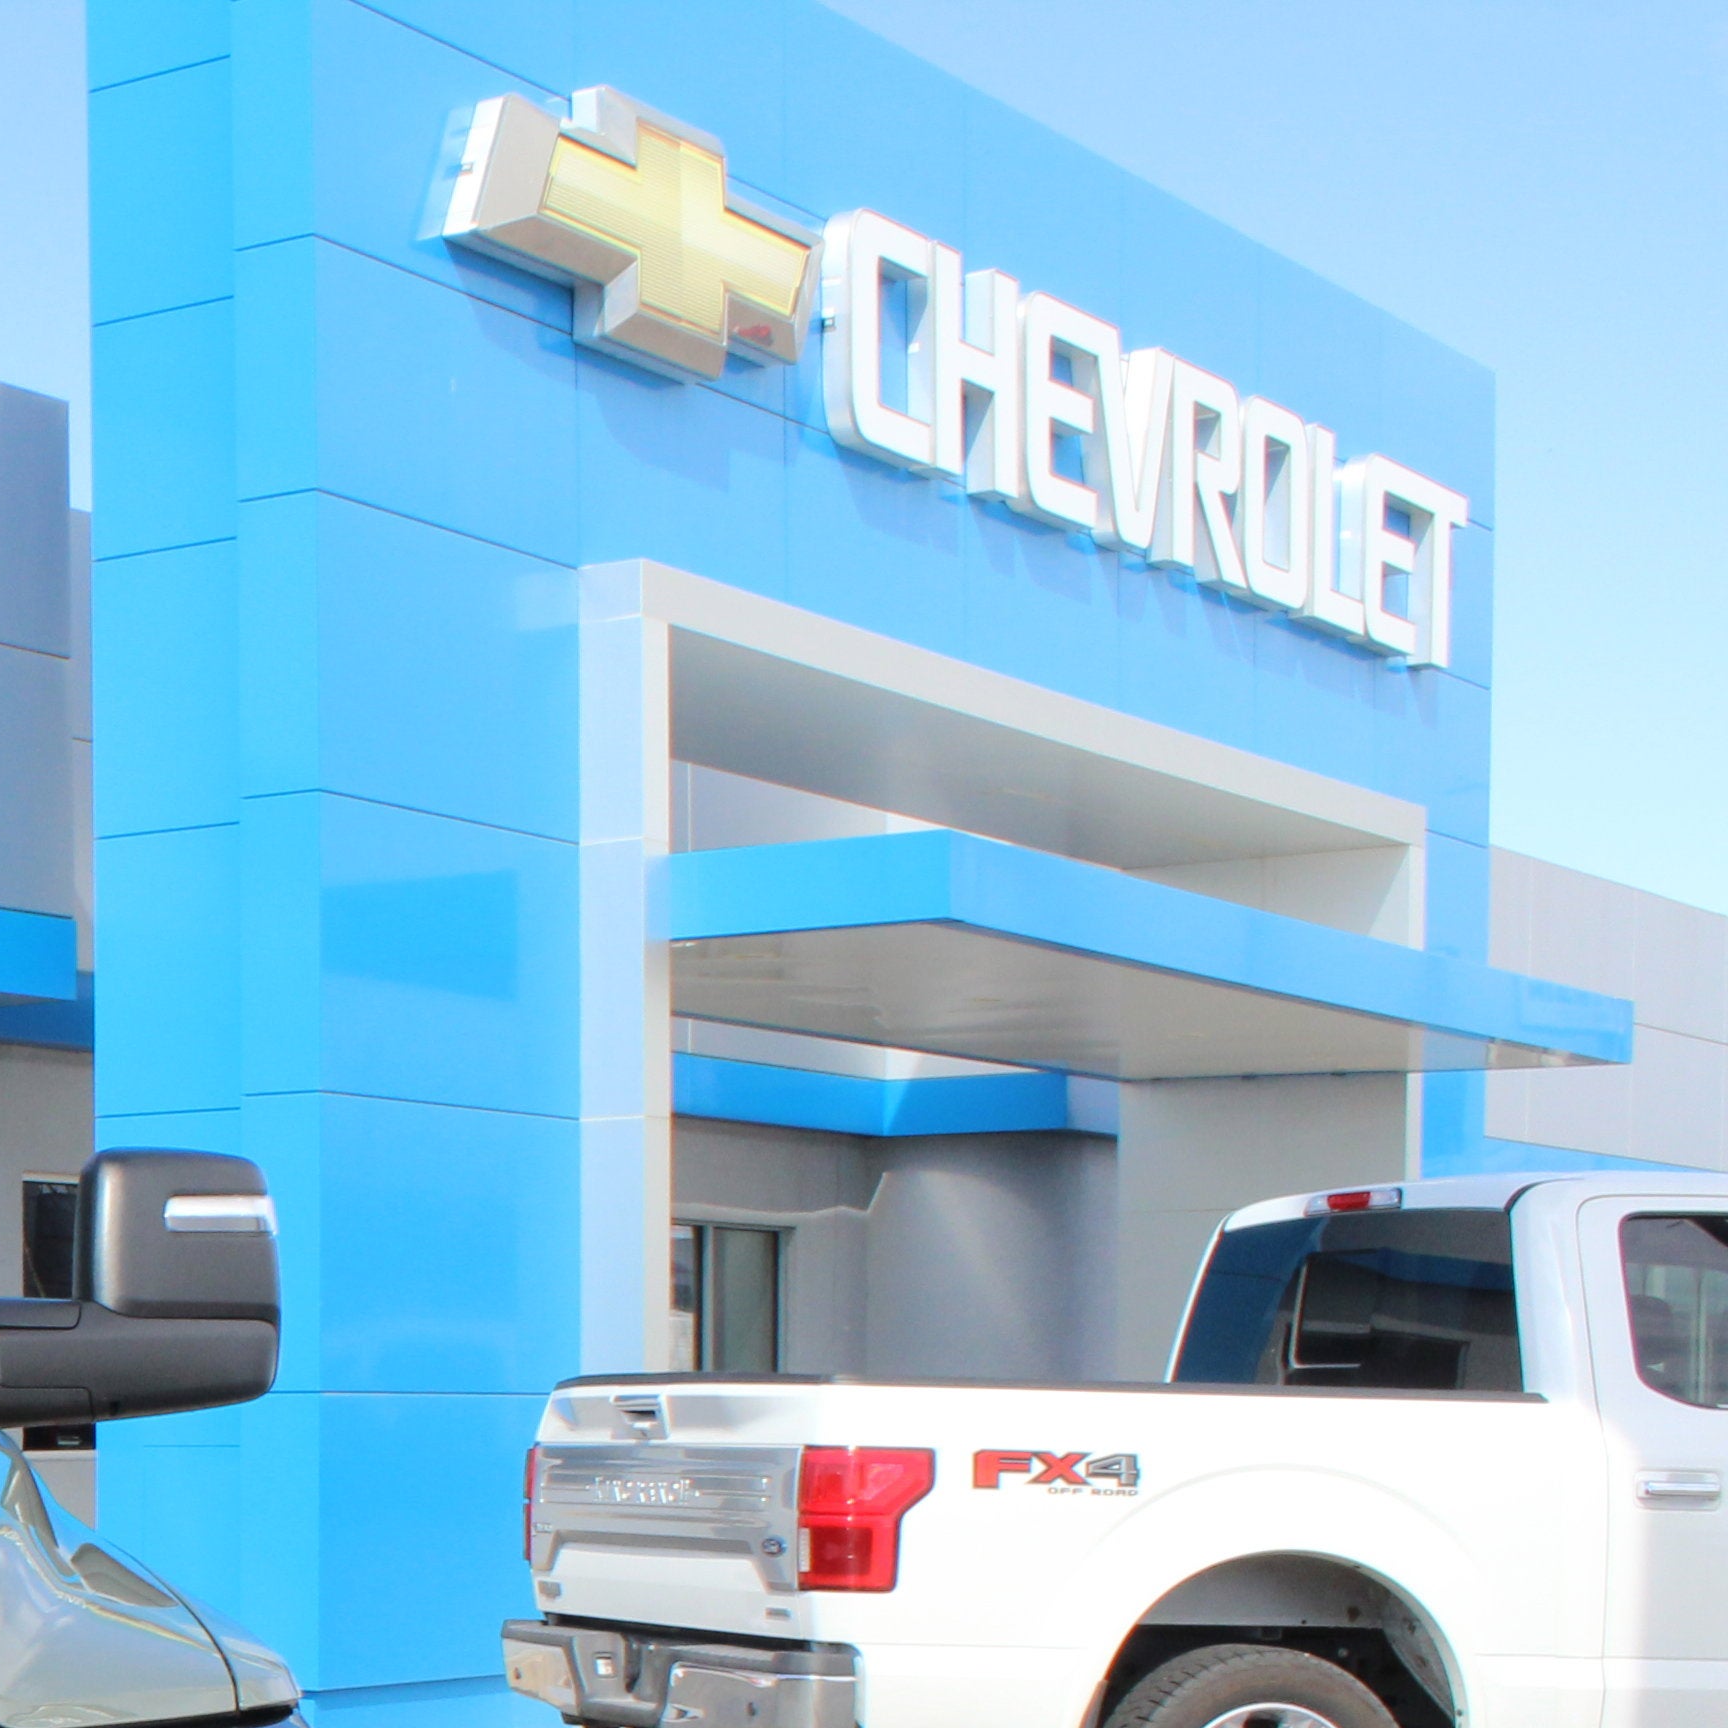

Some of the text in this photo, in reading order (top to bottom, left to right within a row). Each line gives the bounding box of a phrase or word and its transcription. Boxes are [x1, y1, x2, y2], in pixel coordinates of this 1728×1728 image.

[824, 208, 1468, 669] CHEVROLET
[972, 1449, 1141, 1489] FX4
[1047, 1487, 1138, 1496] OFF ROAD
